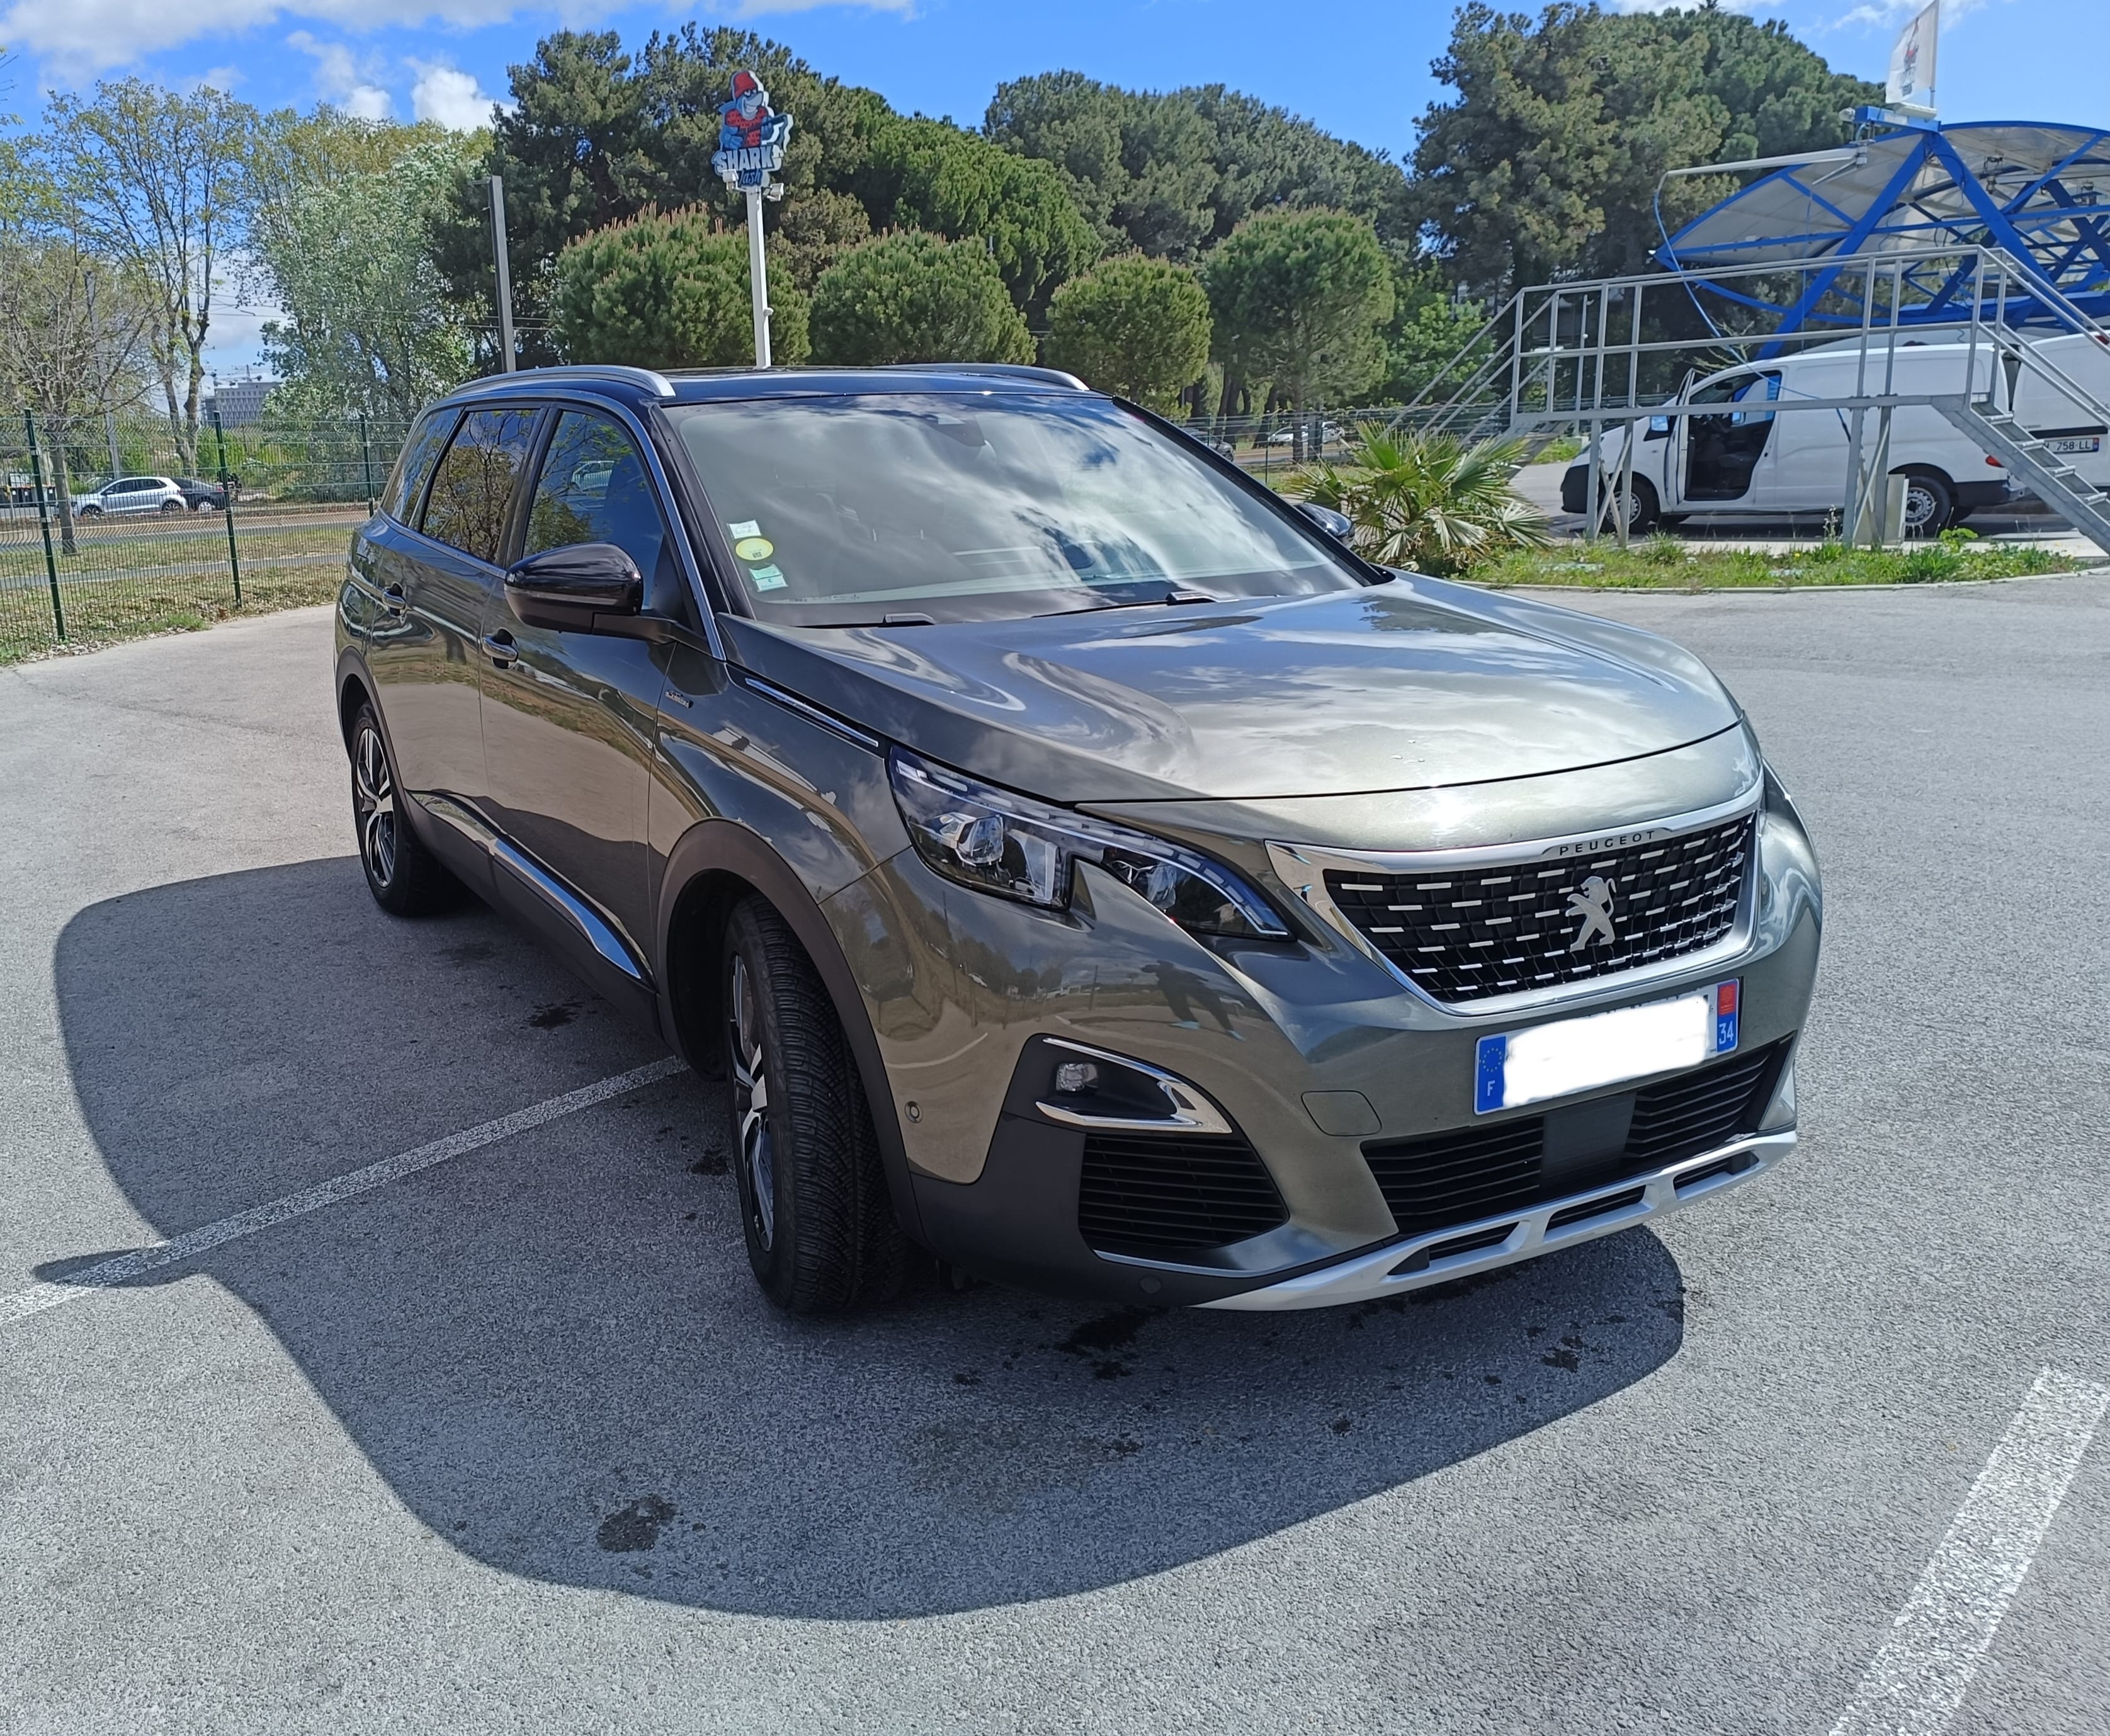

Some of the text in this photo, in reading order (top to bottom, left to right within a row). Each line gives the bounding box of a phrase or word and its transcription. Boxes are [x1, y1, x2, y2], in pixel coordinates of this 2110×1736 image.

[713, 145, 773, 173] SHARK
[738, 169, 761, 186] ash
[2079, 440, 2091, 450] LL
[1560, 831, 1655, 856] PEUGEOT
[1718, 1020, 1734, 1045] 34
[1487, 1080, 1495, 1097] F
